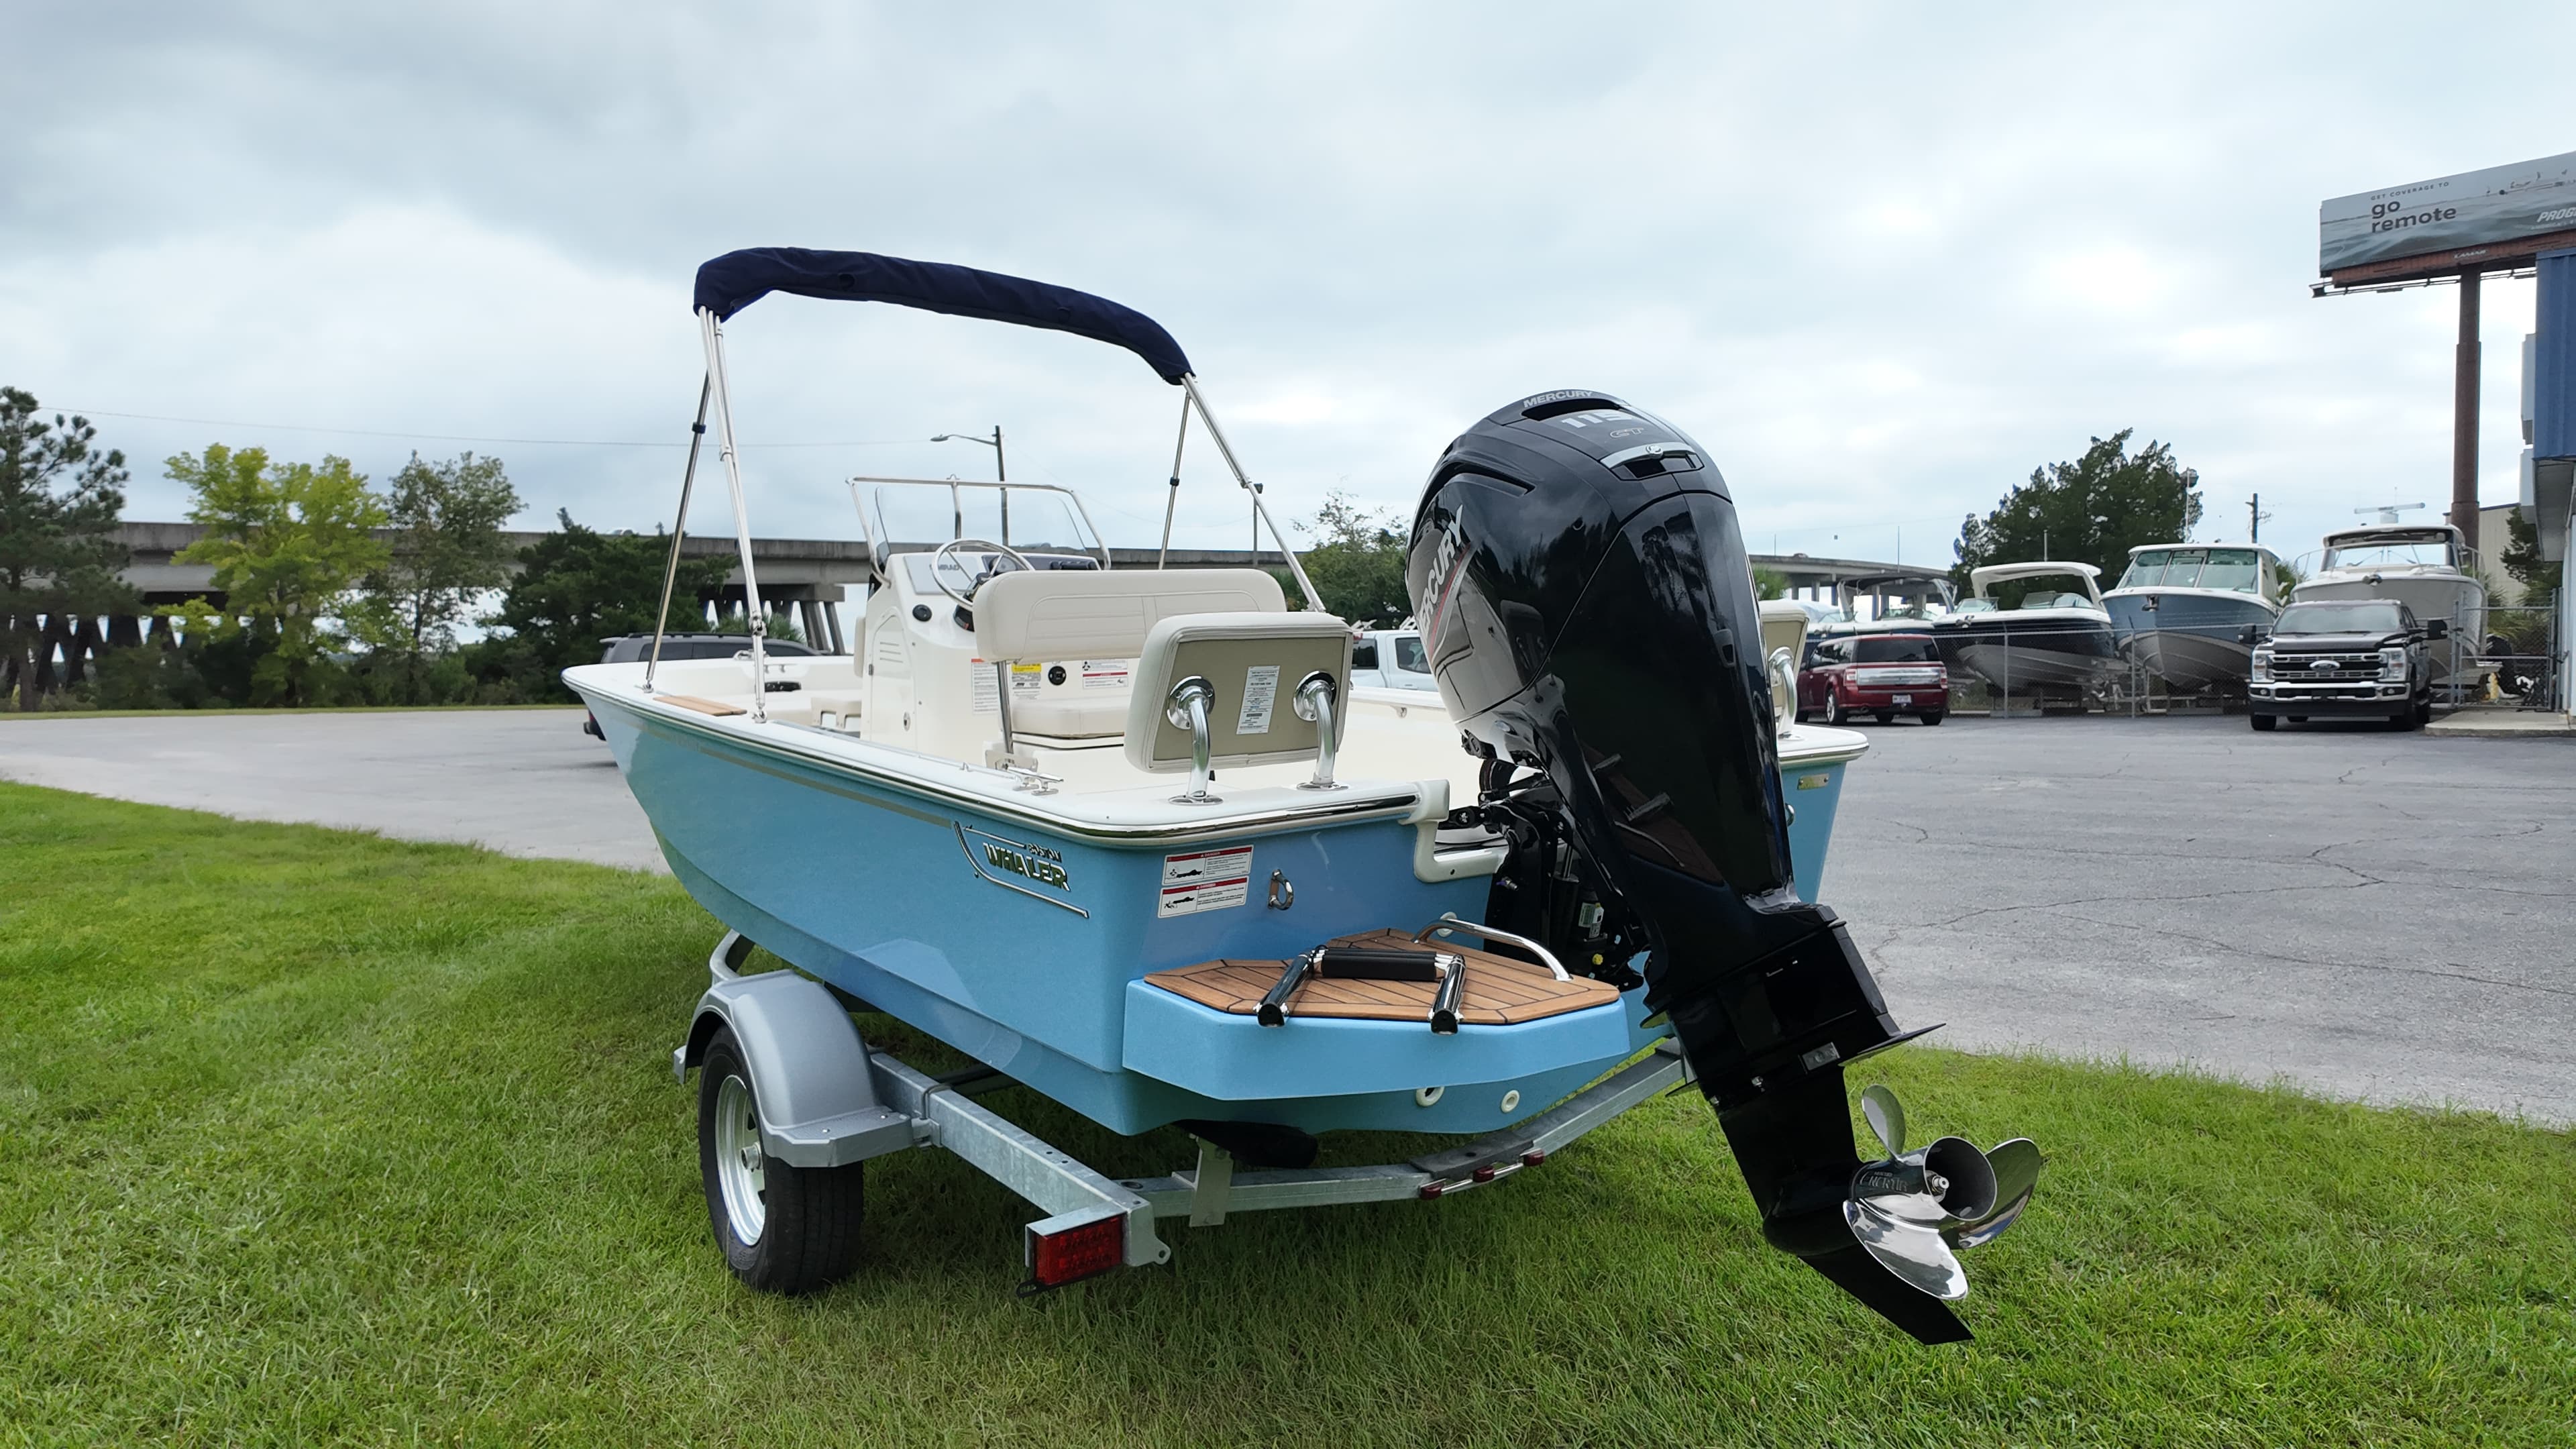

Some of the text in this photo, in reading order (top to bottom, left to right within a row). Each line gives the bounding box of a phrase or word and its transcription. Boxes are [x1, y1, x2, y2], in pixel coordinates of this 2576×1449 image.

[2390, 184, 2434, 197] COVERAGE
[2371, 201, 2400, 219] go
[2536, 207, 2576, 222] PROG
[2371, 208, 2457, 233] remote
[1523, 391, 1593, 408] MERCURY
[1561, 411, 1633, 429] 115
[1610, 427, 1645, 438] GT
[983, 842, 1071, 892] WHALER
